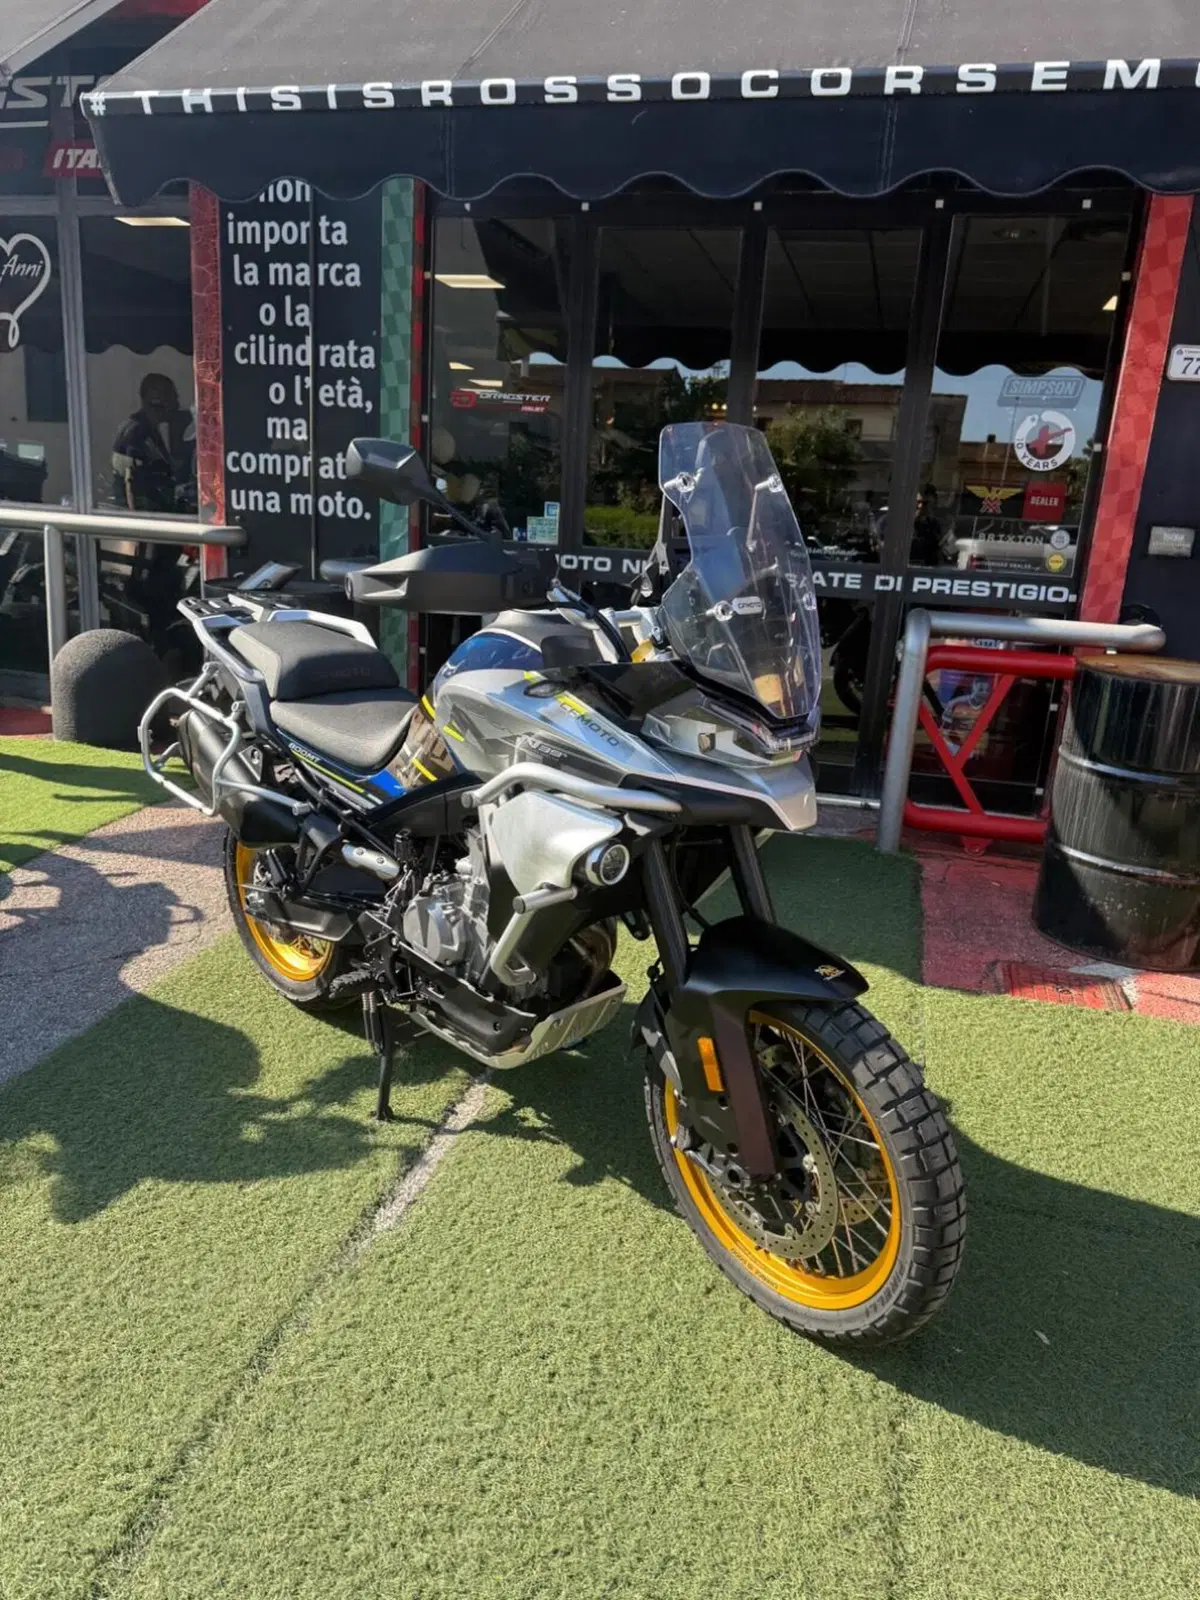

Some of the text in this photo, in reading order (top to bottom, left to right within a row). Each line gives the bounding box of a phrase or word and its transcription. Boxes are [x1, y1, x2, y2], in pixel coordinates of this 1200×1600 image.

[87, 57, 1200, 117] #THISISROSSOCORSEM
[52, 147, 103, 169] ITA
[227, 211, 349, 253] importa
[233, 253, 362, 288] la marca
[259, 294, 311, 327] o la
[234, 333, 377, 370] cilindrata
[268, 381, 286, 406] o
[1010, 379, 1078, 395] SIMPSON
[266, 416, 309, 441] ma
[226, 450, 348, 484] comprat
[1021, 451, 1059, 470] YEARS
[230, 488, 372, 521] una moto.
[1030, 496, 1060, 507] DEALER
[977, 532, 1045, 546] BRIXTON
[554, 554, 613, 573] OTO
[873, 574, 903, 592] DI
[912, 576, 1078, 603] PRESTIGIO.
